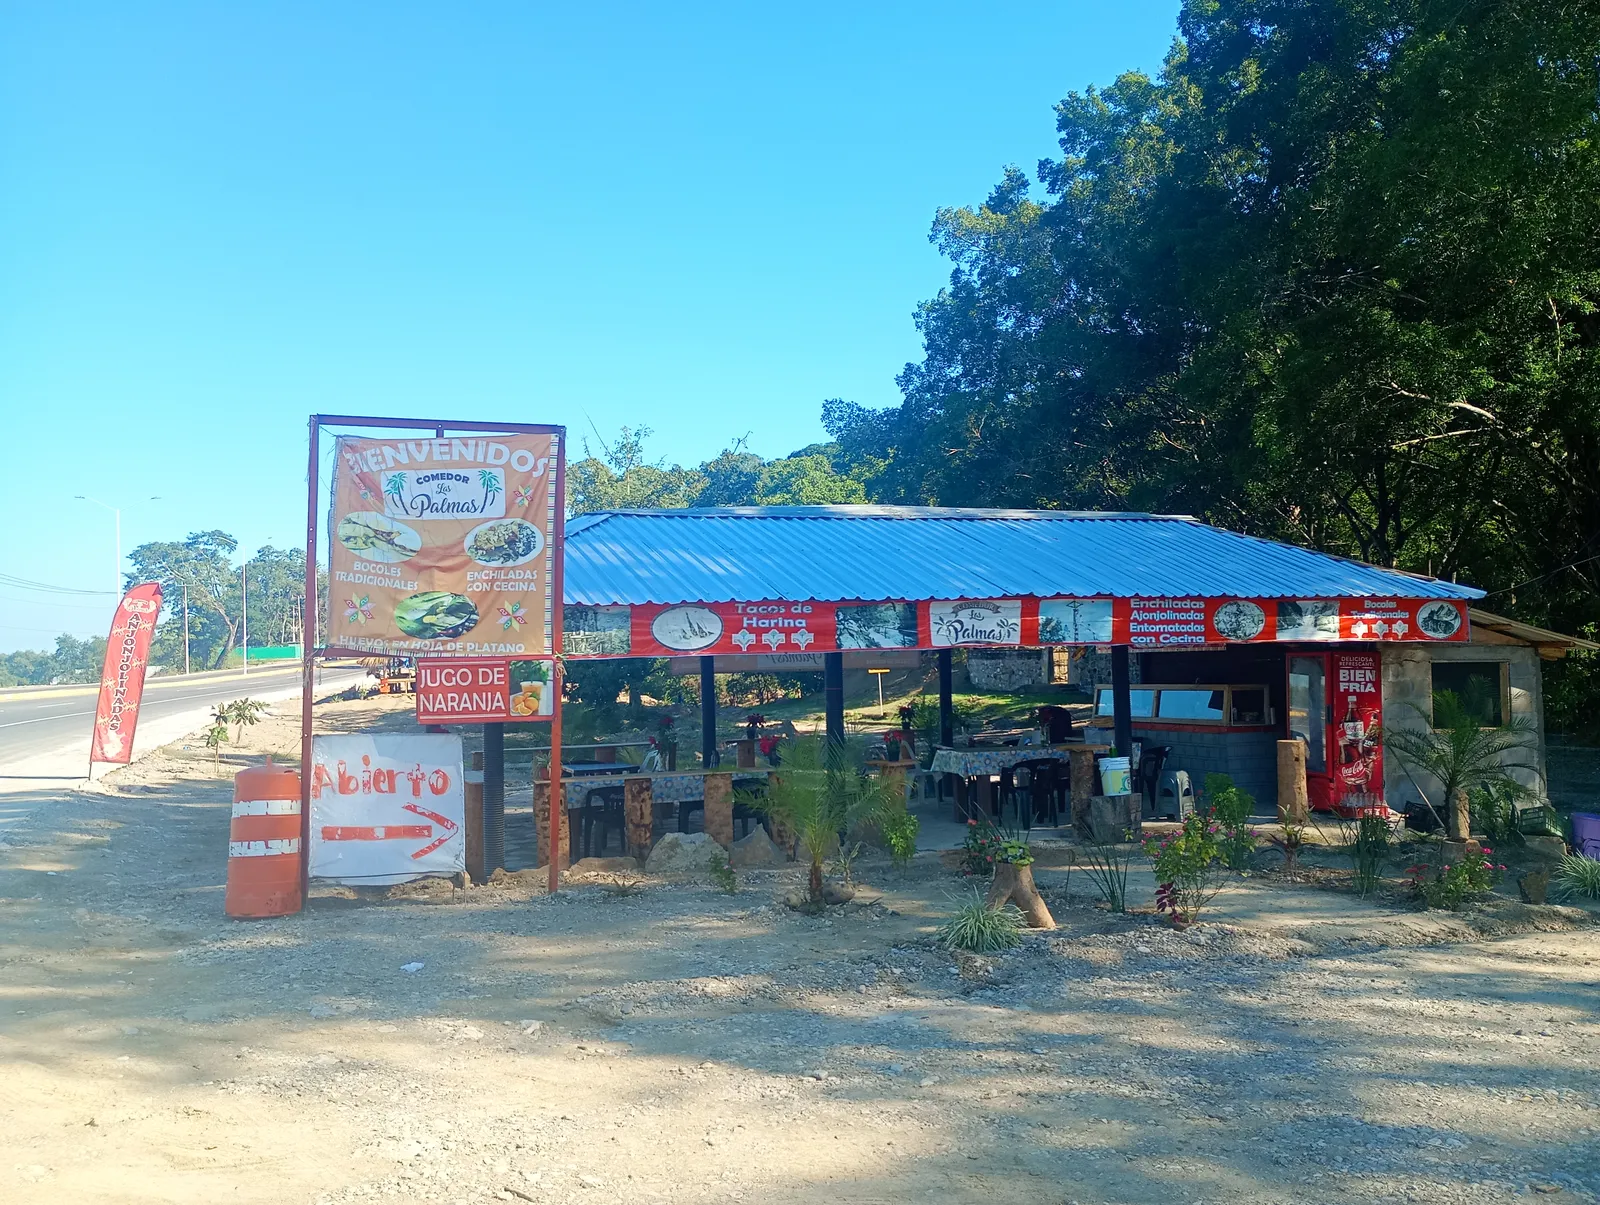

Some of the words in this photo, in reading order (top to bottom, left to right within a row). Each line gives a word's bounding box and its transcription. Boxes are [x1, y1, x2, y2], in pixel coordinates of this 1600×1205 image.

[416, 472, 470, 485] COMEDOR
[436, 483, 452, 496] Las
[410, 493, 481, 518] Palmas
[353, 561, 402, 577] BOCOLES
[466, 569, 538, 581] ENCHILADAS
[335, 570, 419, 591] TRADICIONALES
[466, 581, 492, 592] CON
[493, 581, 537, 592] CECINA
[734, 603, 786, 614] Tacos
[790, 602, 813, 614] de
[1130, 598, 1206, 609] Enchiladas
[1364, 600, 1397, 609] Bocoles
[967, 609, 985, 621] Las
[1129, 609, 1205, 621] Ajonjolinadas
[742, 616, 807, 628] Harina
[1129, 622, 1206, 633] Entomatadas
[949, 619, 1002, 643] Palmas
[1130, 635, 1156, 643] con
[1159, 633, 1206, 643] Cecina
[391, 640, 409, 649] EN
[410, 640, 444, 651] HOJA
[446, 641, 464, 652] DE
[466, 642, 526, 653] PLATANO
[109, 612, 142, 732] ANJONJOLINADAS
[420, 668, 472, 688] JUGO
[478, 667, 506, 686] DE
[1339, 669, 1376, 682] BIEN
[1339, 682, 1376, 693] FRÍA
[419, 691, 506, 713] NARANJA
[312, 755, 452, 800] Abierto
